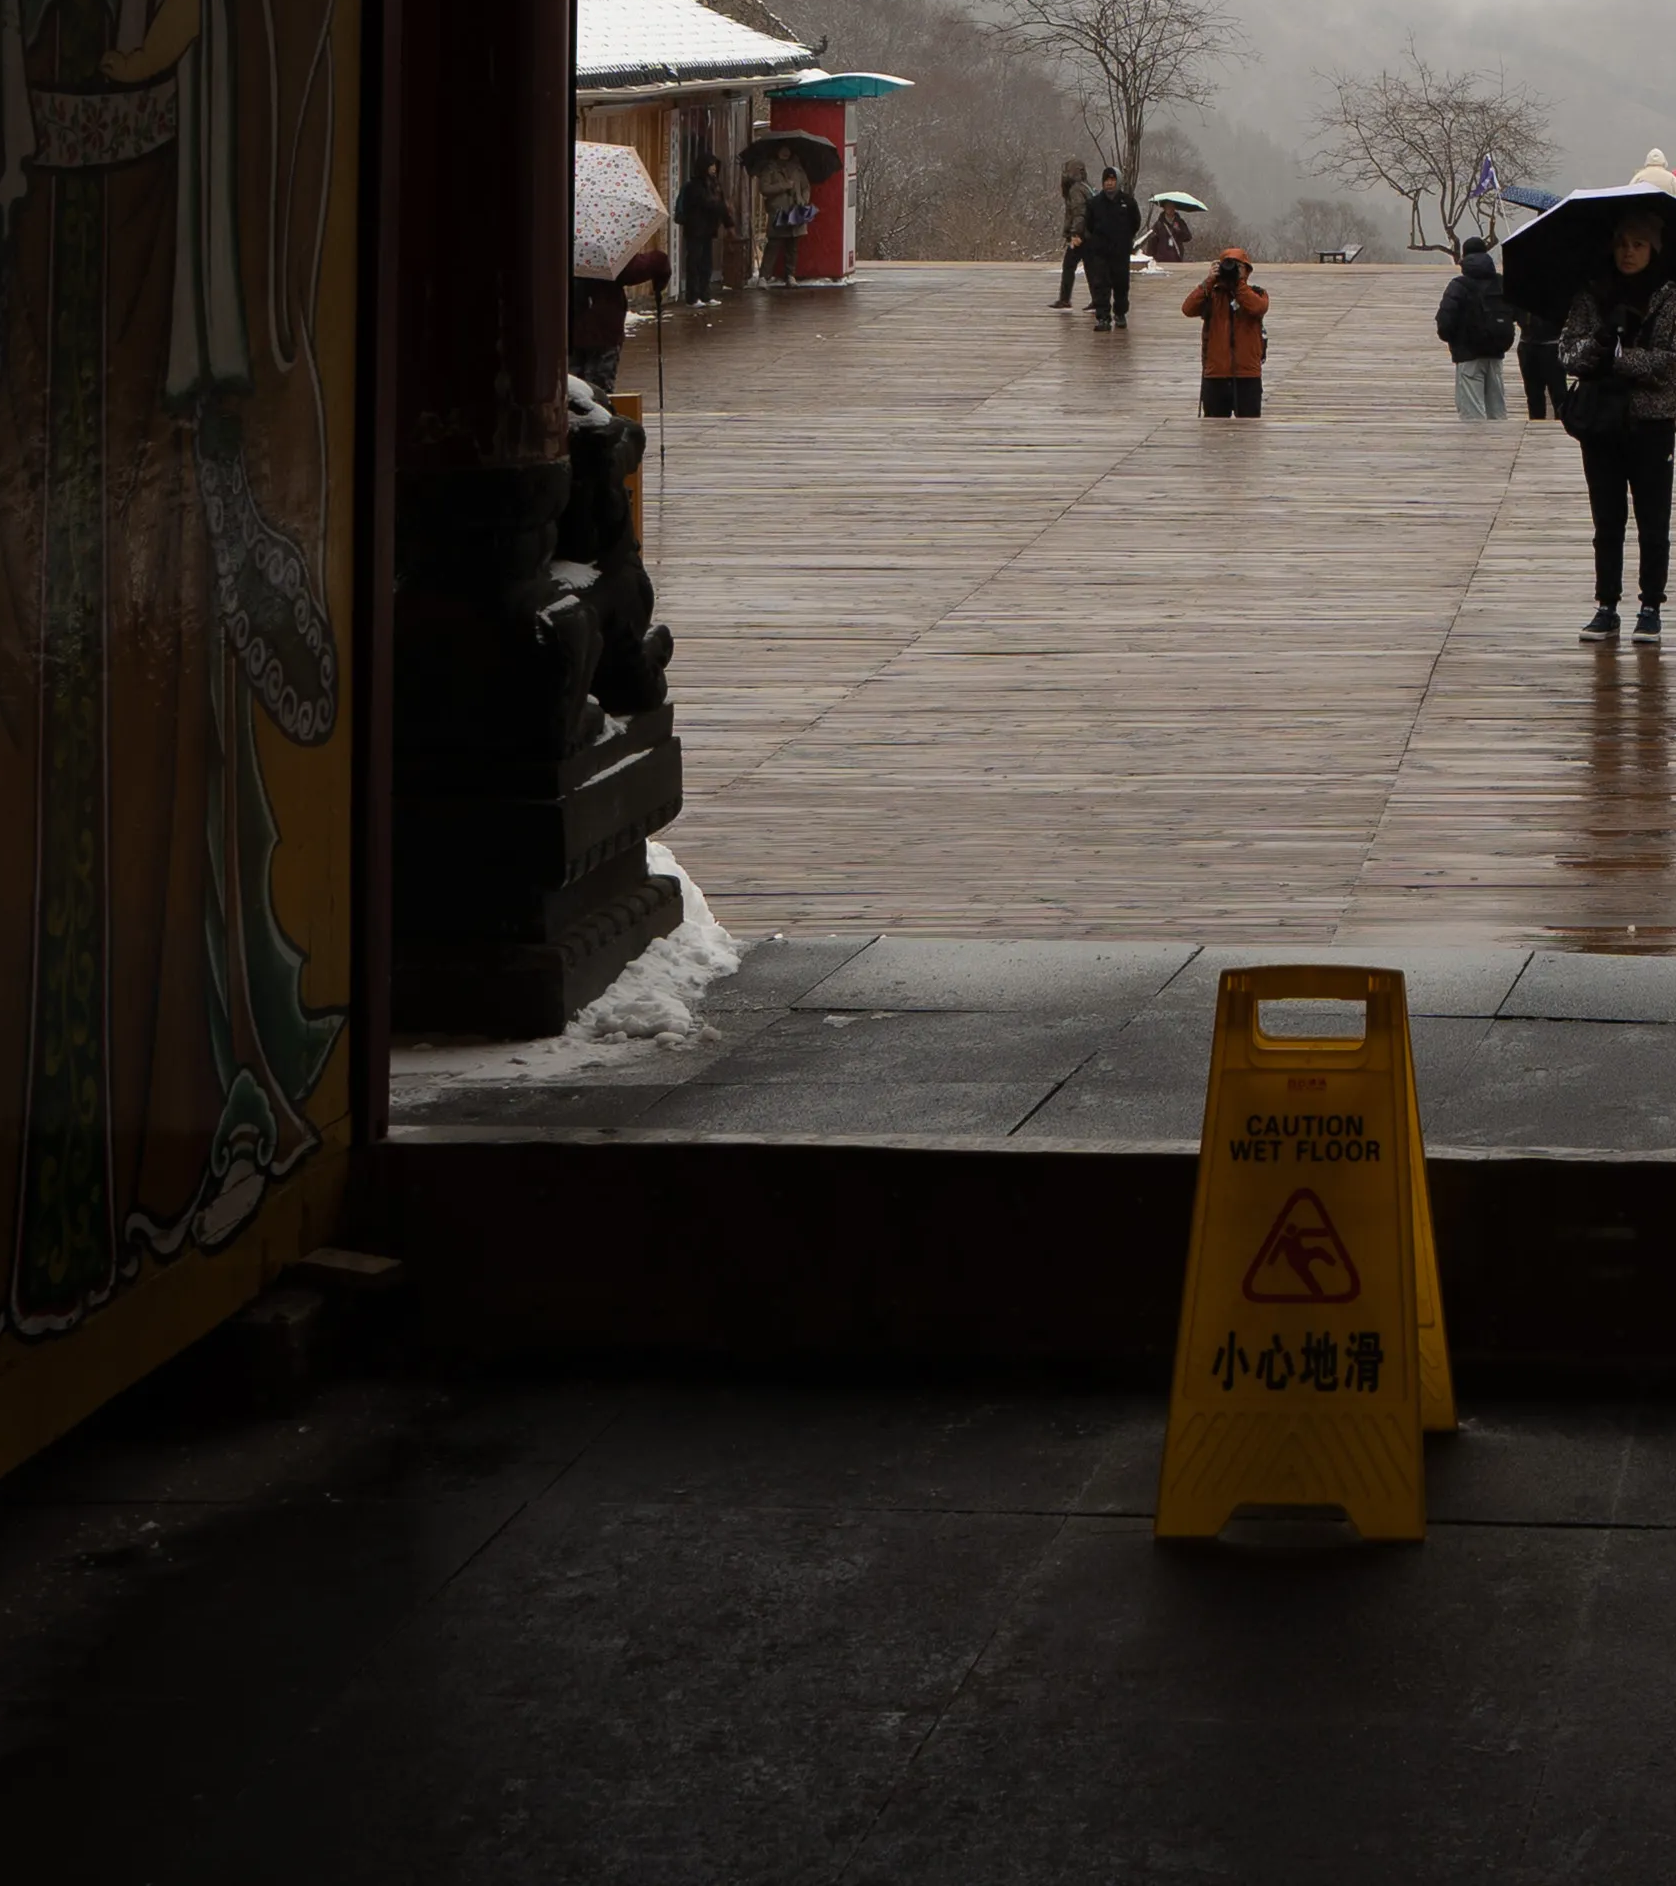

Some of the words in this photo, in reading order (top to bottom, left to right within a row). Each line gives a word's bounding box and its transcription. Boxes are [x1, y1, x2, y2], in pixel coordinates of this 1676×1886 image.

[1246, 1114, 1363, 1137] CAUTION
[1229, 1140, 1283, 1162] WET
[1296, 1141, 1381, 1162] FLOOR
[1212, 1330, 1384, 1392] 小心地滑
